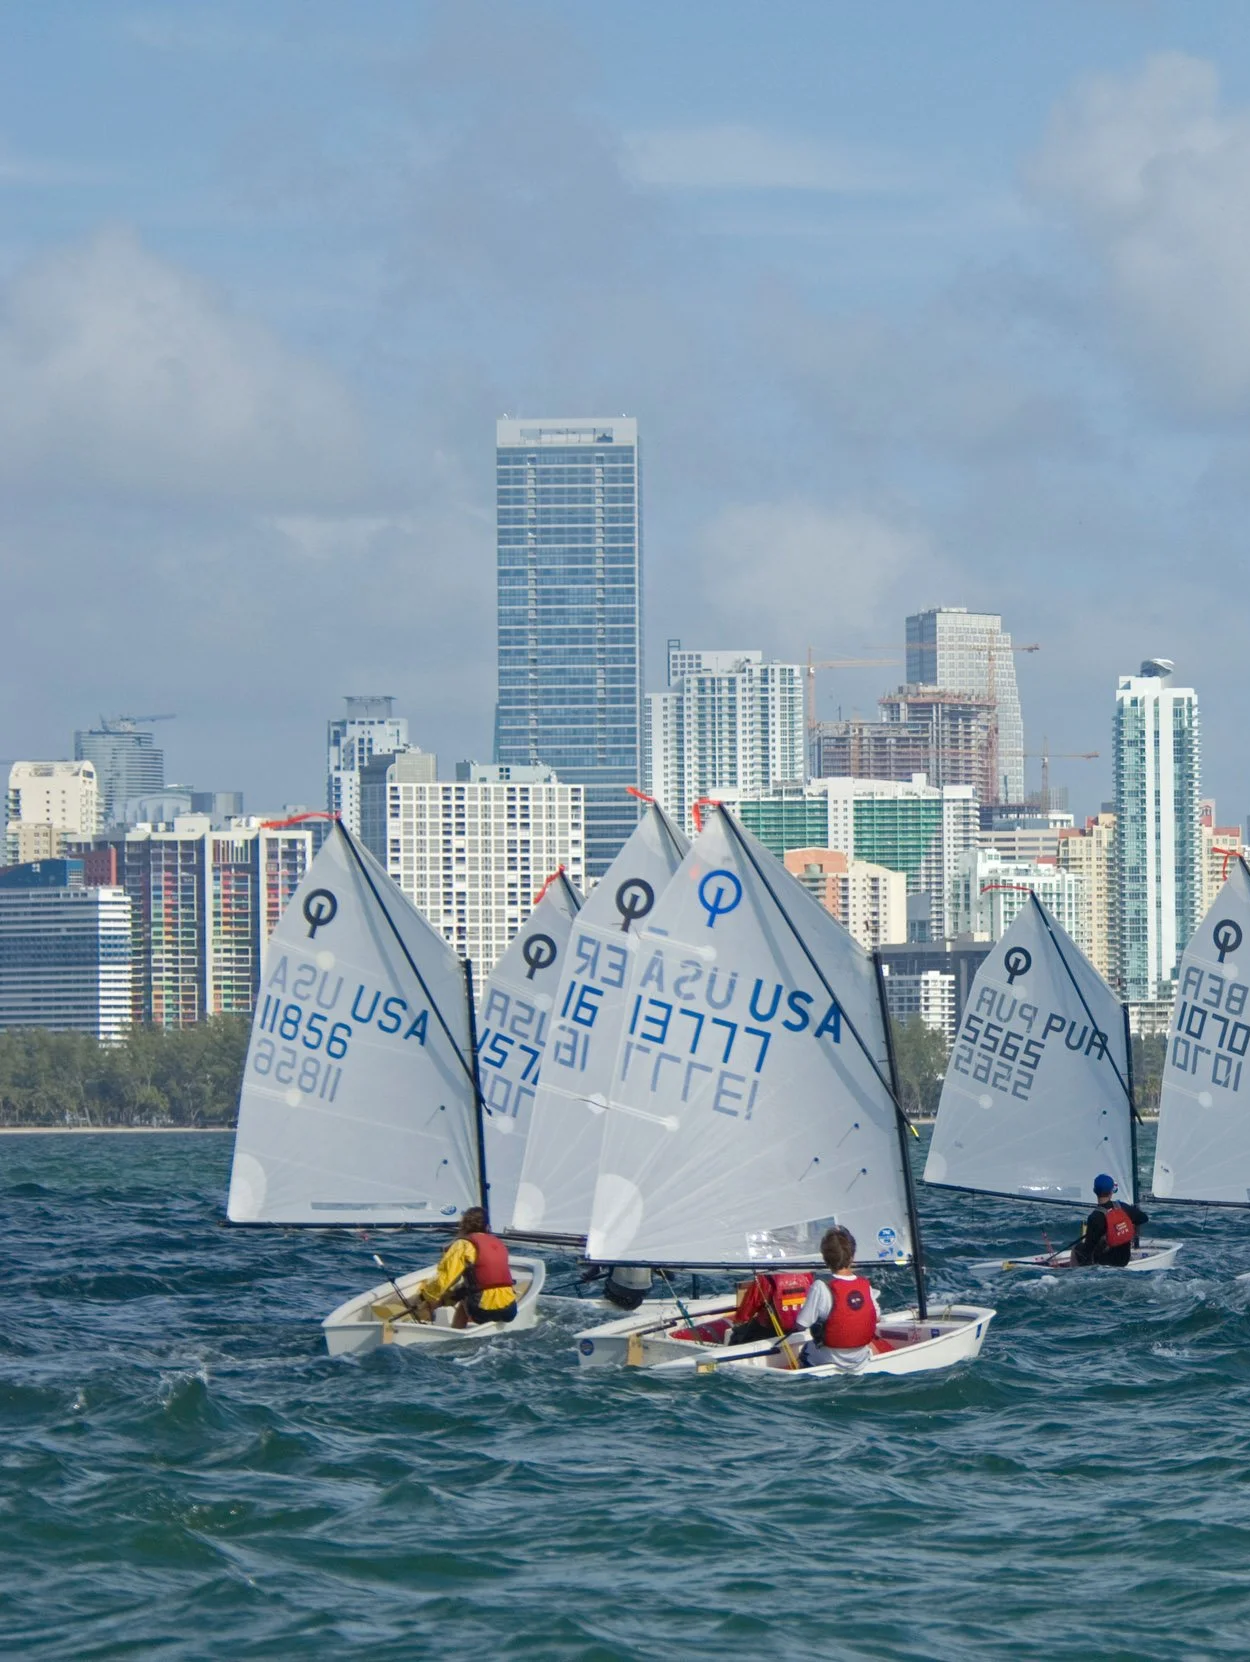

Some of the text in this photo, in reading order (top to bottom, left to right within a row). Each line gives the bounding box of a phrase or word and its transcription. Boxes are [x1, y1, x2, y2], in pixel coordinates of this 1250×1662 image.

[260, 994, 352, 1059] 11856
[350, 984, 429, 1047] USA
[561, 980, 604, 1028] 16
[629, 994, 772, 1074] 13777
[748, 978, 842, 1044] USA
[477, 1028, 541, 1086] 157
[961, 1013, 1045, 1070] 5565
[1041, 1012, 1109, 1060] PUR
